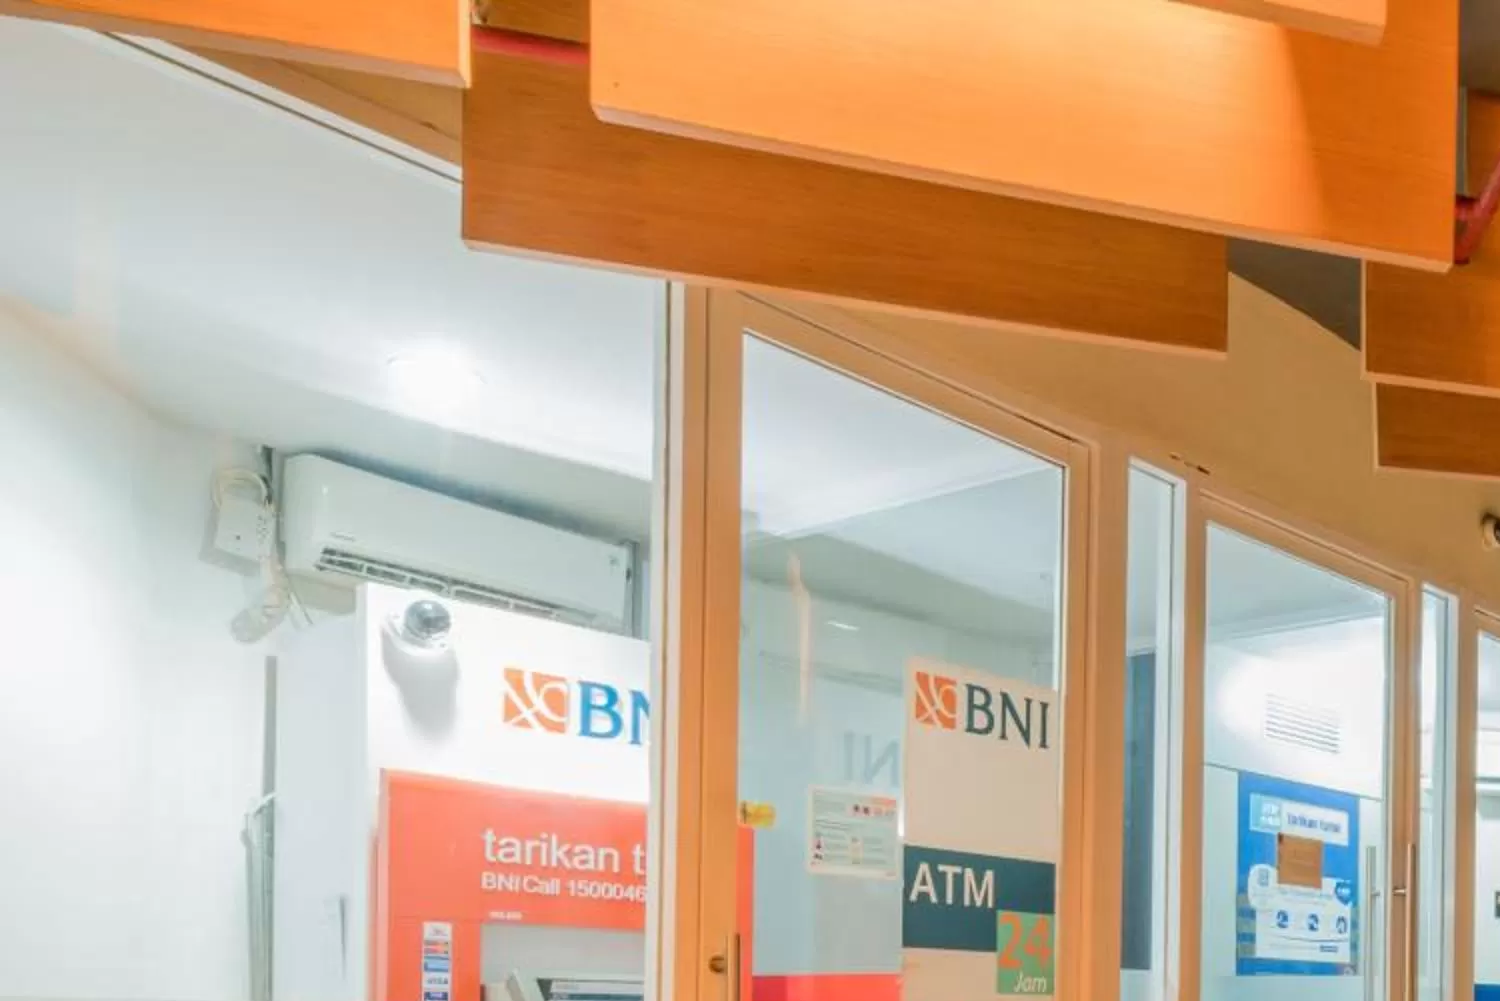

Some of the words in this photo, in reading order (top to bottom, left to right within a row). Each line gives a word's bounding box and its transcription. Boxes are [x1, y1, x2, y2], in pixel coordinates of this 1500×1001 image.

[964, 683, 1049, 750] BNI
[482, 828, 620, 873] tarikan
[481, 871, 519, 893] BNI
[522, 875, 561, 896] Call
[909, 863, 995, 908] ATM
[999, 911, 1050, 971] 24
[1014, 972, 1047, 993] Jam
